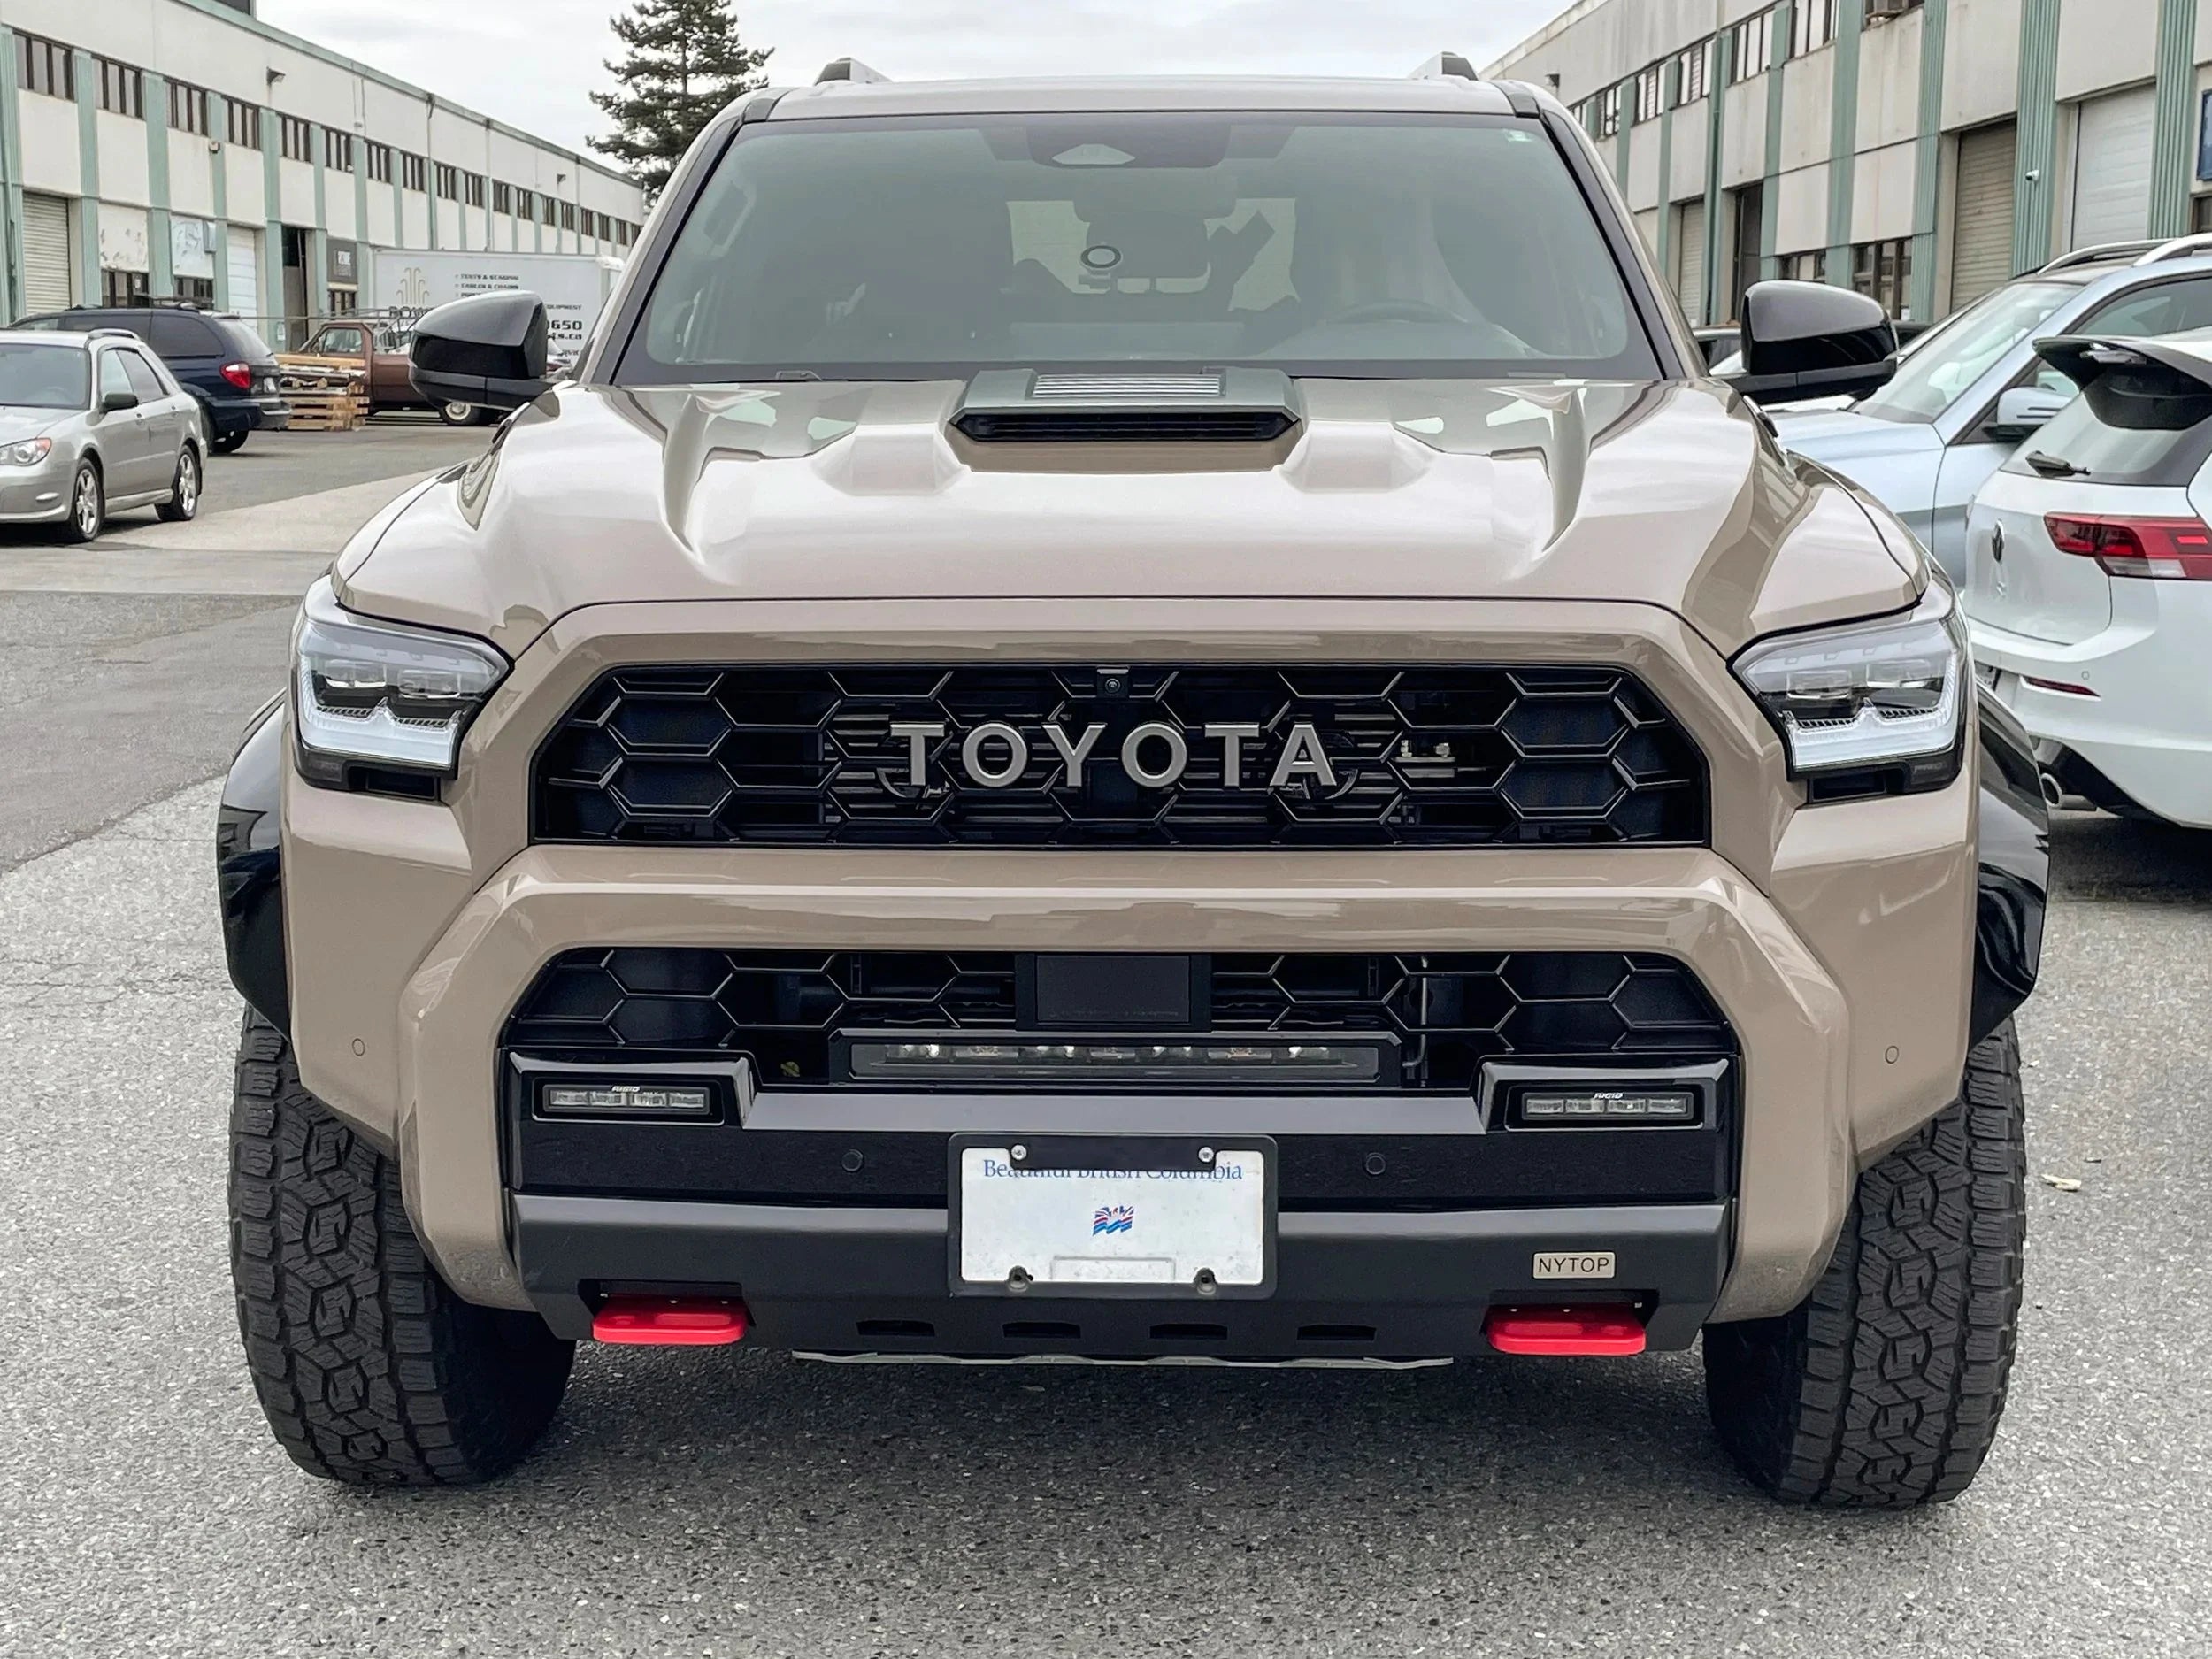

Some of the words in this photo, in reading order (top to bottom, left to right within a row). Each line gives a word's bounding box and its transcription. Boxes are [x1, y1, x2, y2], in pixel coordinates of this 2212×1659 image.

[547, 319, 583, 330] 650
[889, 722, 1337, 787] TOYOTA
[1538, 1257, 1609, 1272] NYTOP
